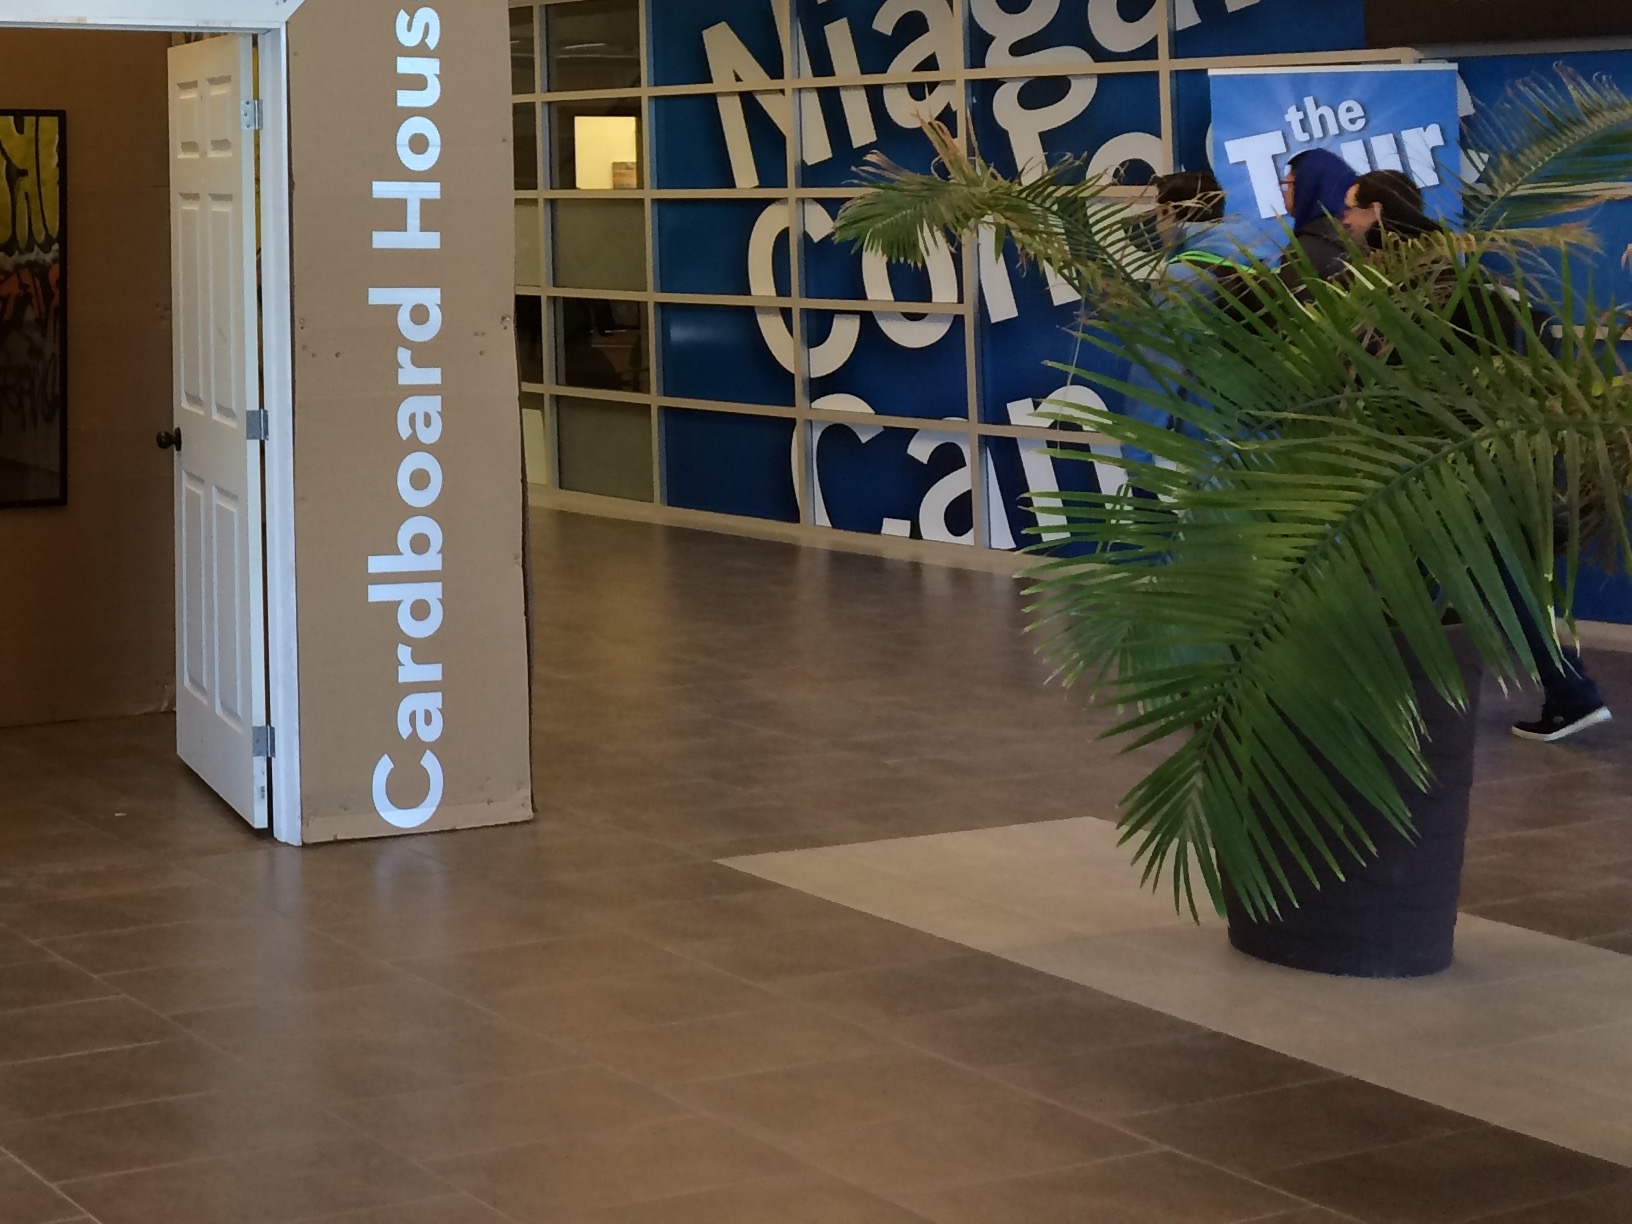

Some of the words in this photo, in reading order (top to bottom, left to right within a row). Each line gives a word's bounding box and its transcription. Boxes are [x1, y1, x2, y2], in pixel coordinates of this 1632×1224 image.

[1284, 95, 1367, 143] the
[1224, 122, 1445, 219] Tur
[368, 287, 445, 830] Cardboard
